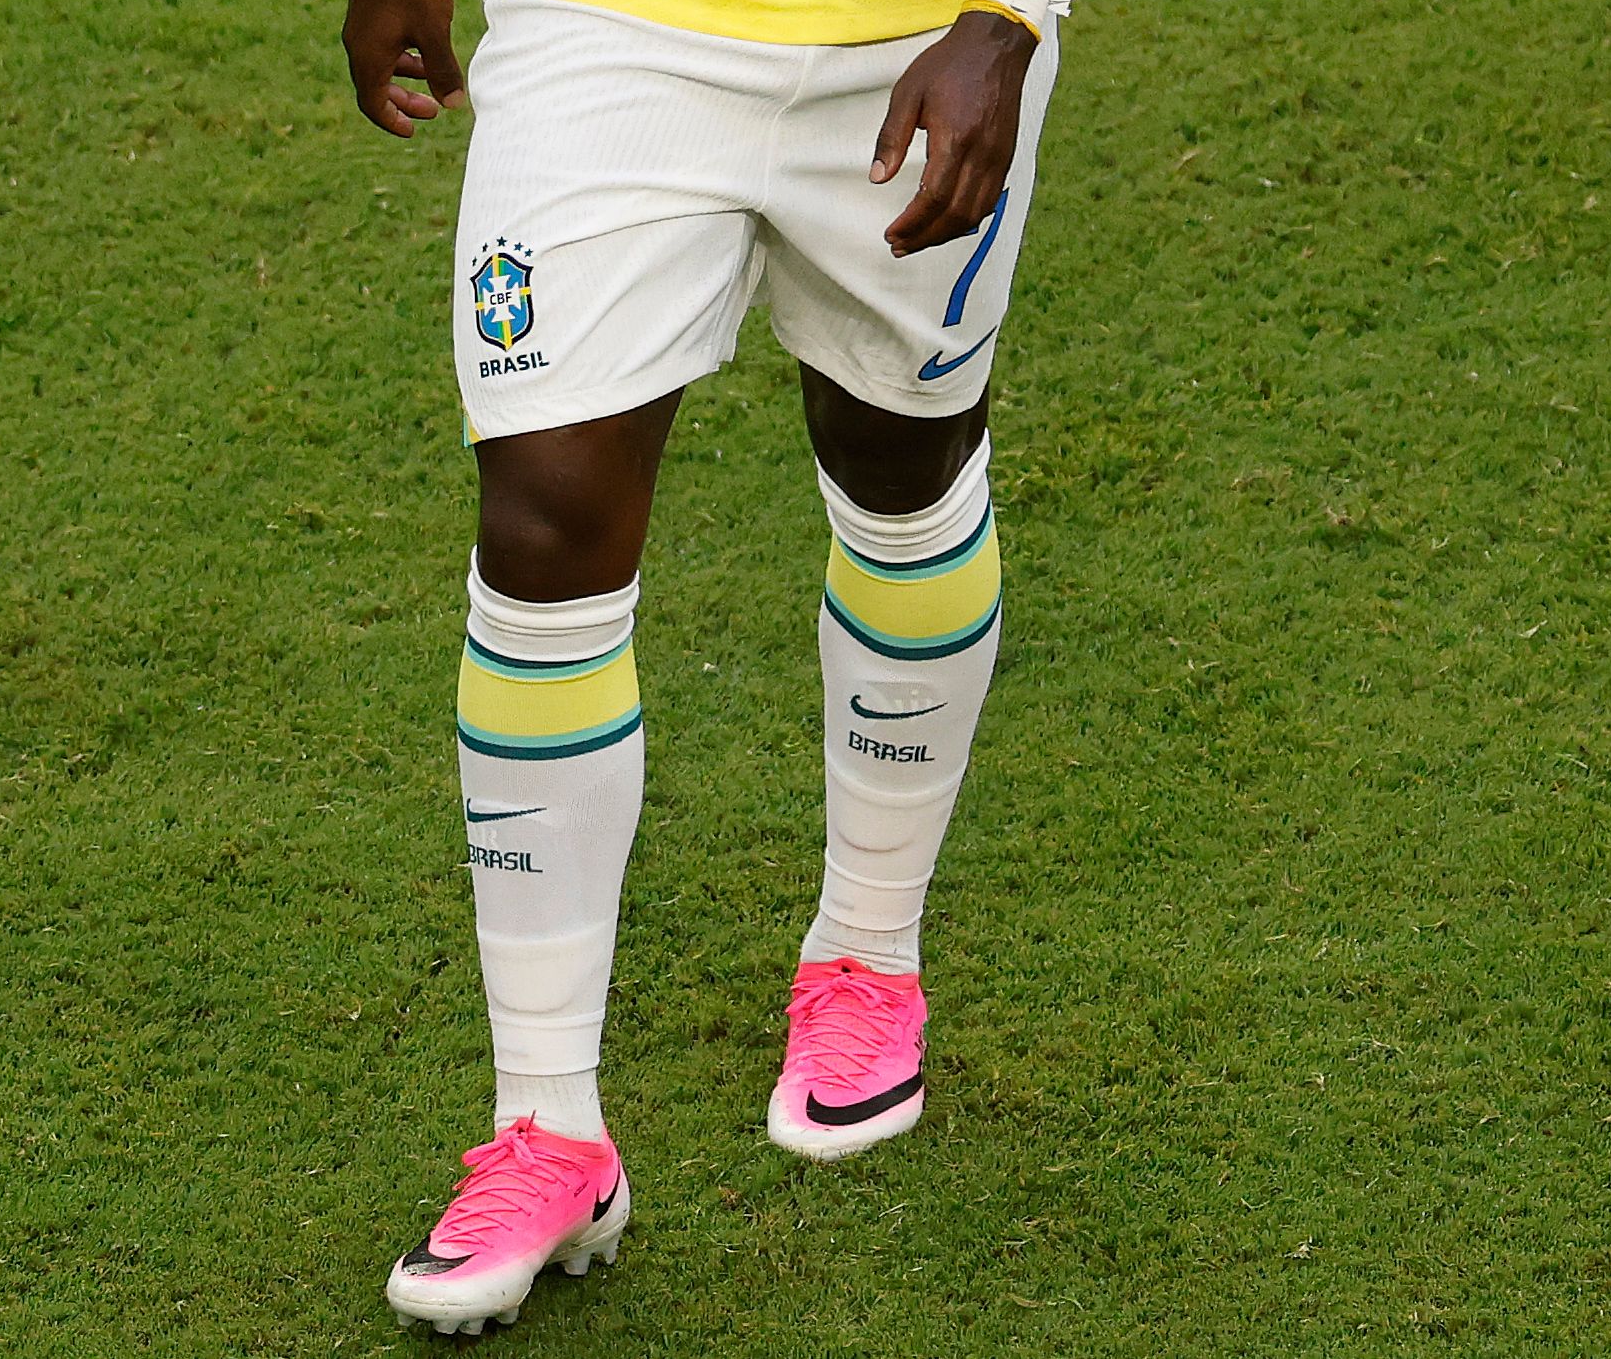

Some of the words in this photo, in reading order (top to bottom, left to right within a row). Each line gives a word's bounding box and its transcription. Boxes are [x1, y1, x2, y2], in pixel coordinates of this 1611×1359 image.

[490, 292, 512, 305] CBF
[479, 351, 550, 378] BRASIL
[848, 730, 935, 762] BRASIL
[467, 844, 543, 874] BRASIL
